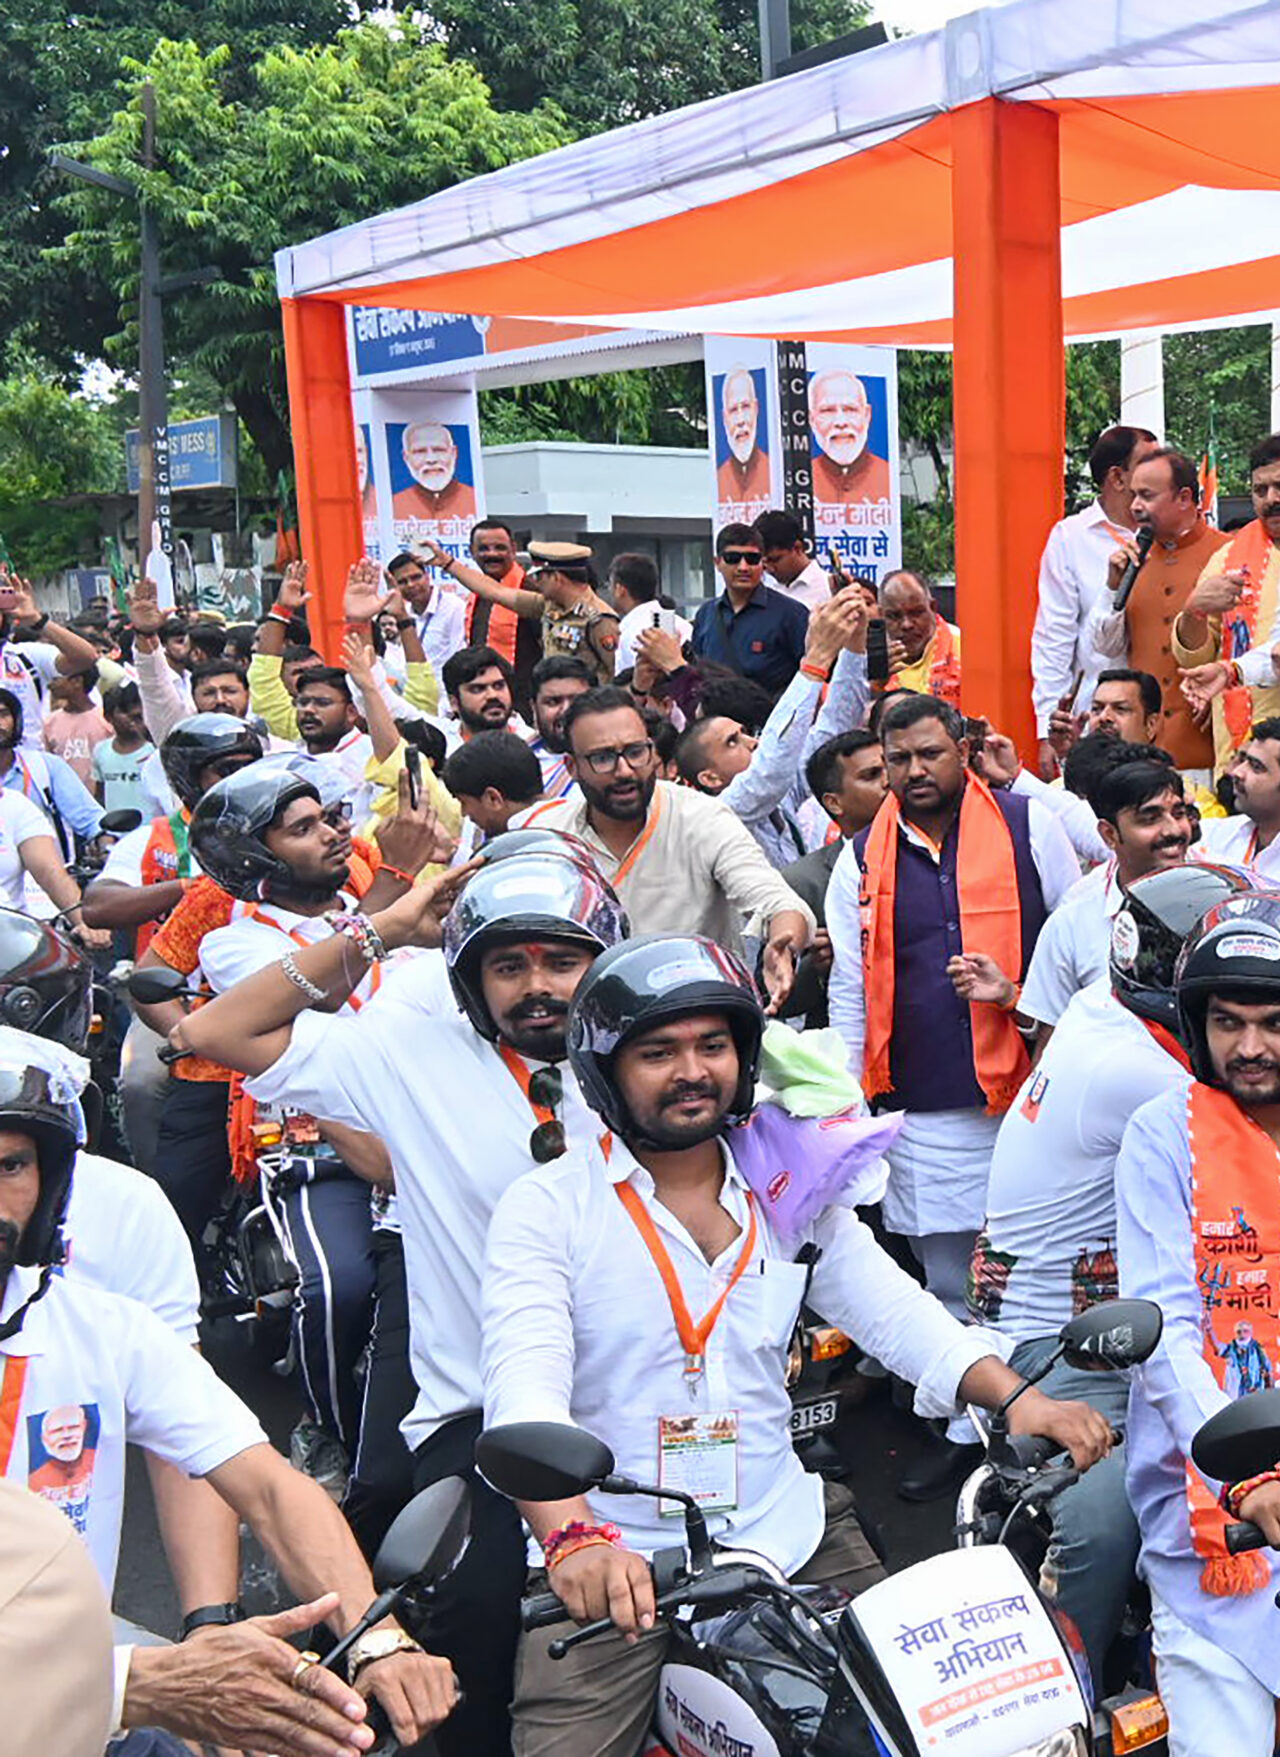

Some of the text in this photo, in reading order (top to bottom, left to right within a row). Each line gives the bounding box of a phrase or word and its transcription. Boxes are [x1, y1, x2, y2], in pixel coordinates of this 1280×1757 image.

[833, 529, 868, 557] सेवा
[871, 530, 889, 557] से
[1200, 1221, 1236, 1236] हमार
[1236, 1269, 1268, 1285] हमार
[1225, 1283, 1279, 1319] मोदी
[791, 1404, 833, 1430] 8153
[893, 1595, 1031, 1655] सेवा संकल्प
[934, 1632, 1028, 1684] अभियान
